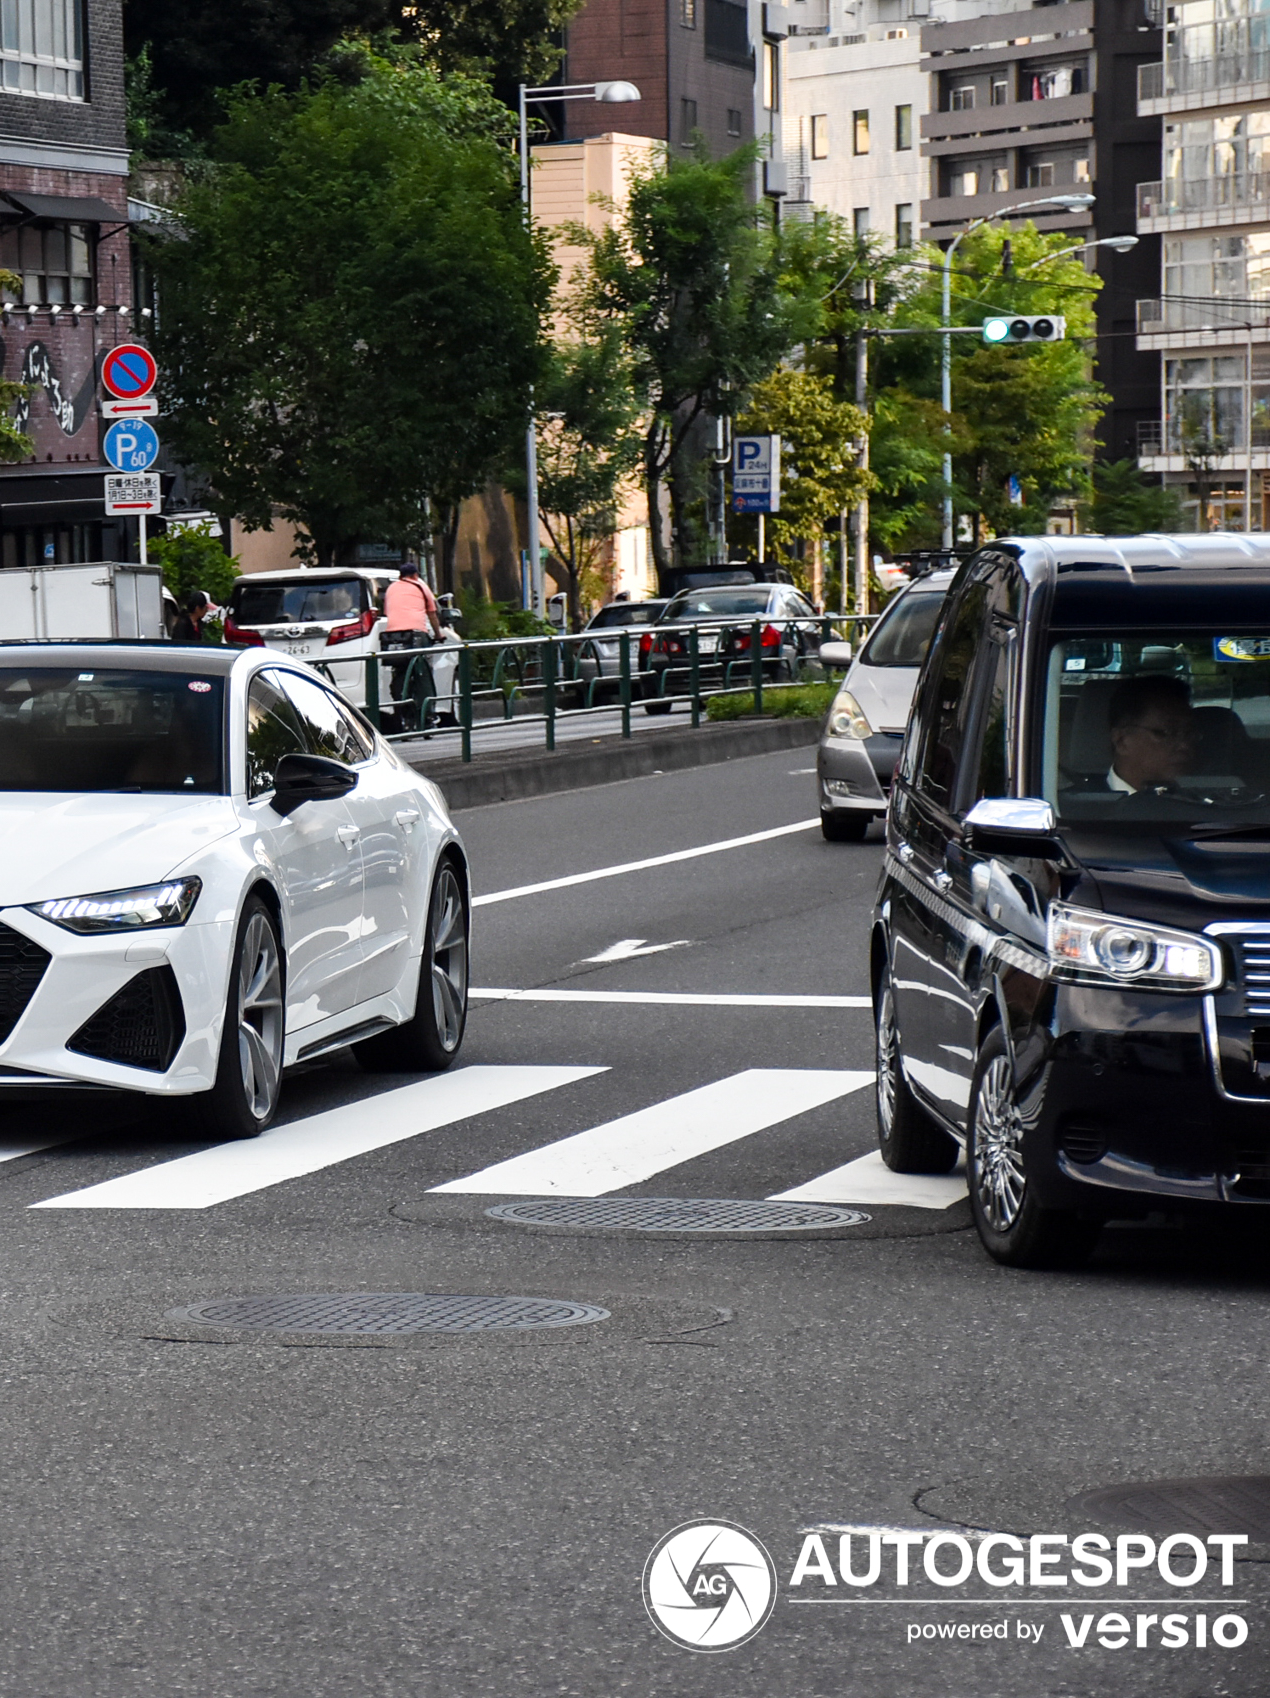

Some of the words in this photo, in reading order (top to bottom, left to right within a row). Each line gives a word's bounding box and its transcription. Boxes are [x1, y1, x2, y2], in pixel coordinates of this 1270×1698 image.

[119, 421, 143, 431] 9-19
[116, 433, 137, 468] P
[738, 441, 761, 470] P
